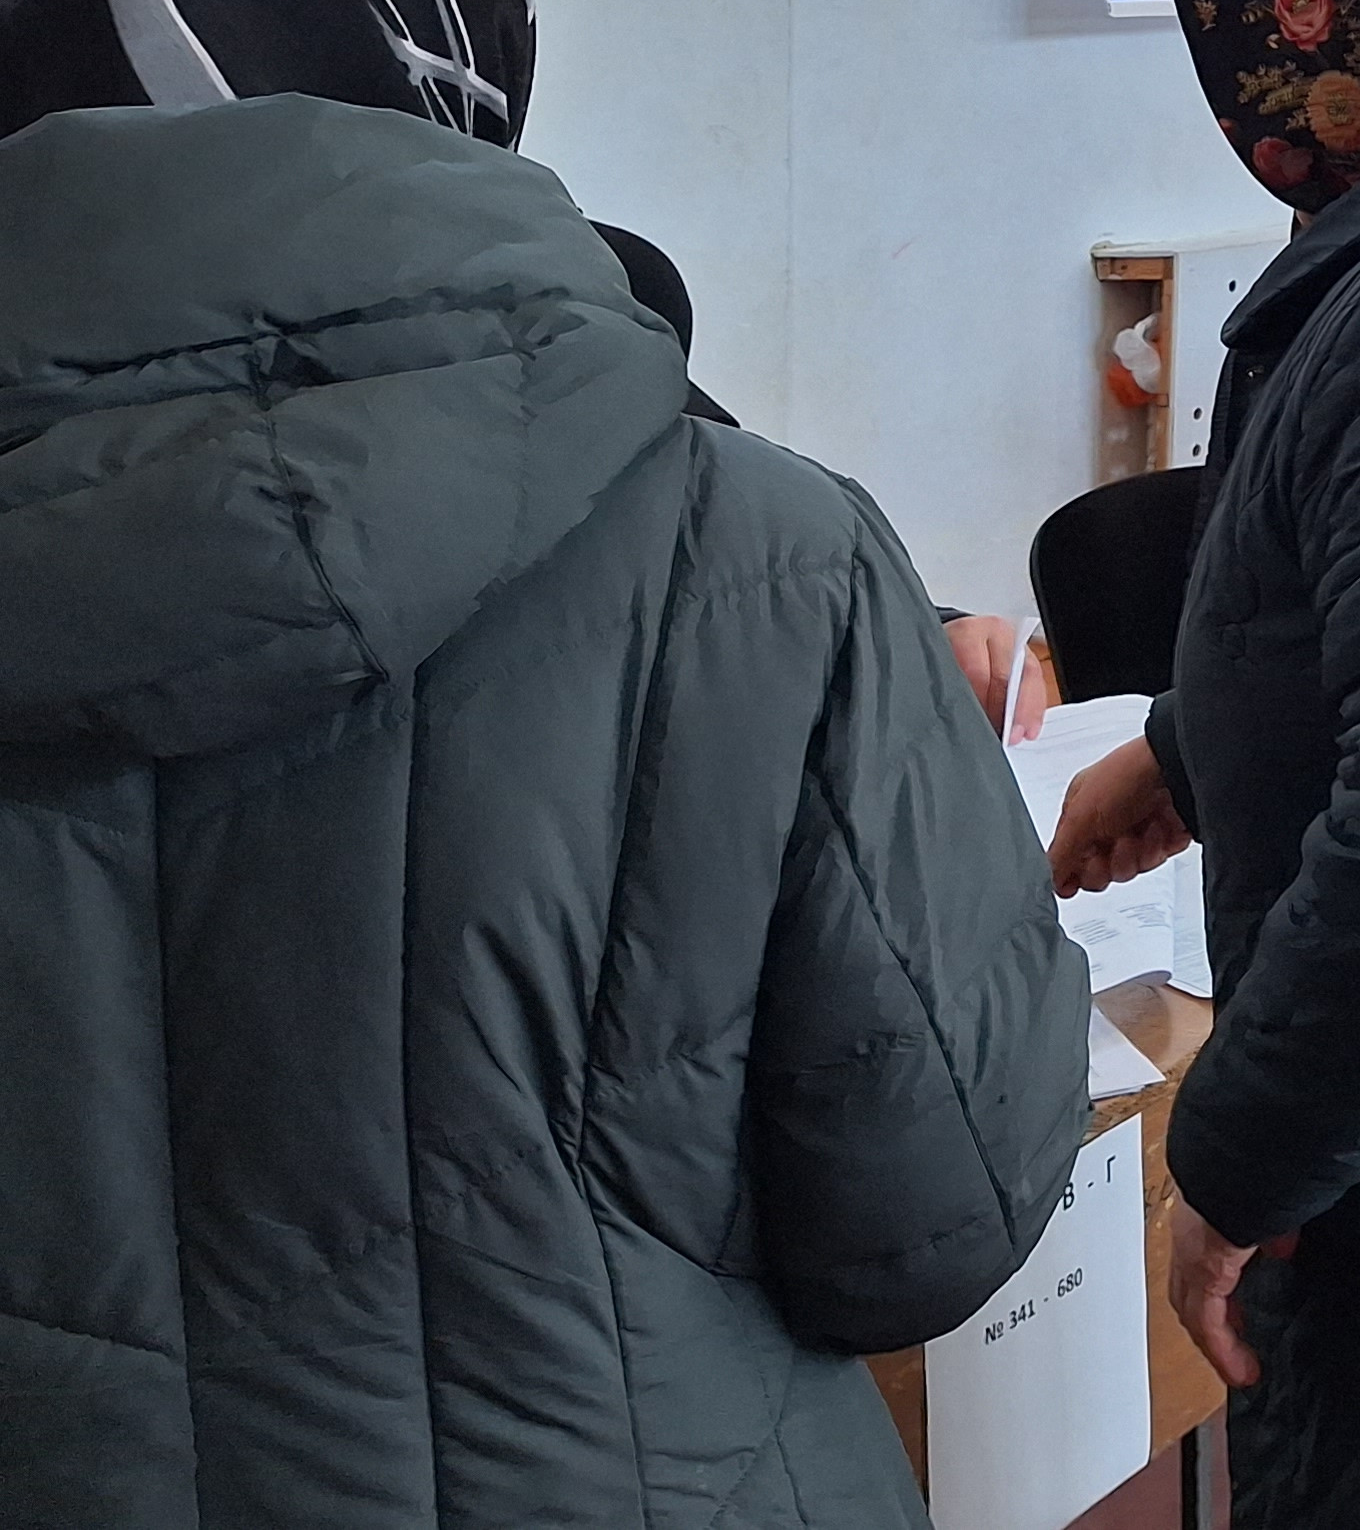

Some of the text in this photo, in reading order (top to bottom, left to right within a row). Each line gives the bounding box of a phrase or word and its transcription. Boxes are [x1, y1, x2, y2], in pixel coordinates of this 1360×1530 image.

[1106, 1155, 1116, 1184] Г
[984, 1320, 1004, 1345] №
[1009, 1299, 1036, 1329] 341
[1056, 1267, 1083, 1297] 680
